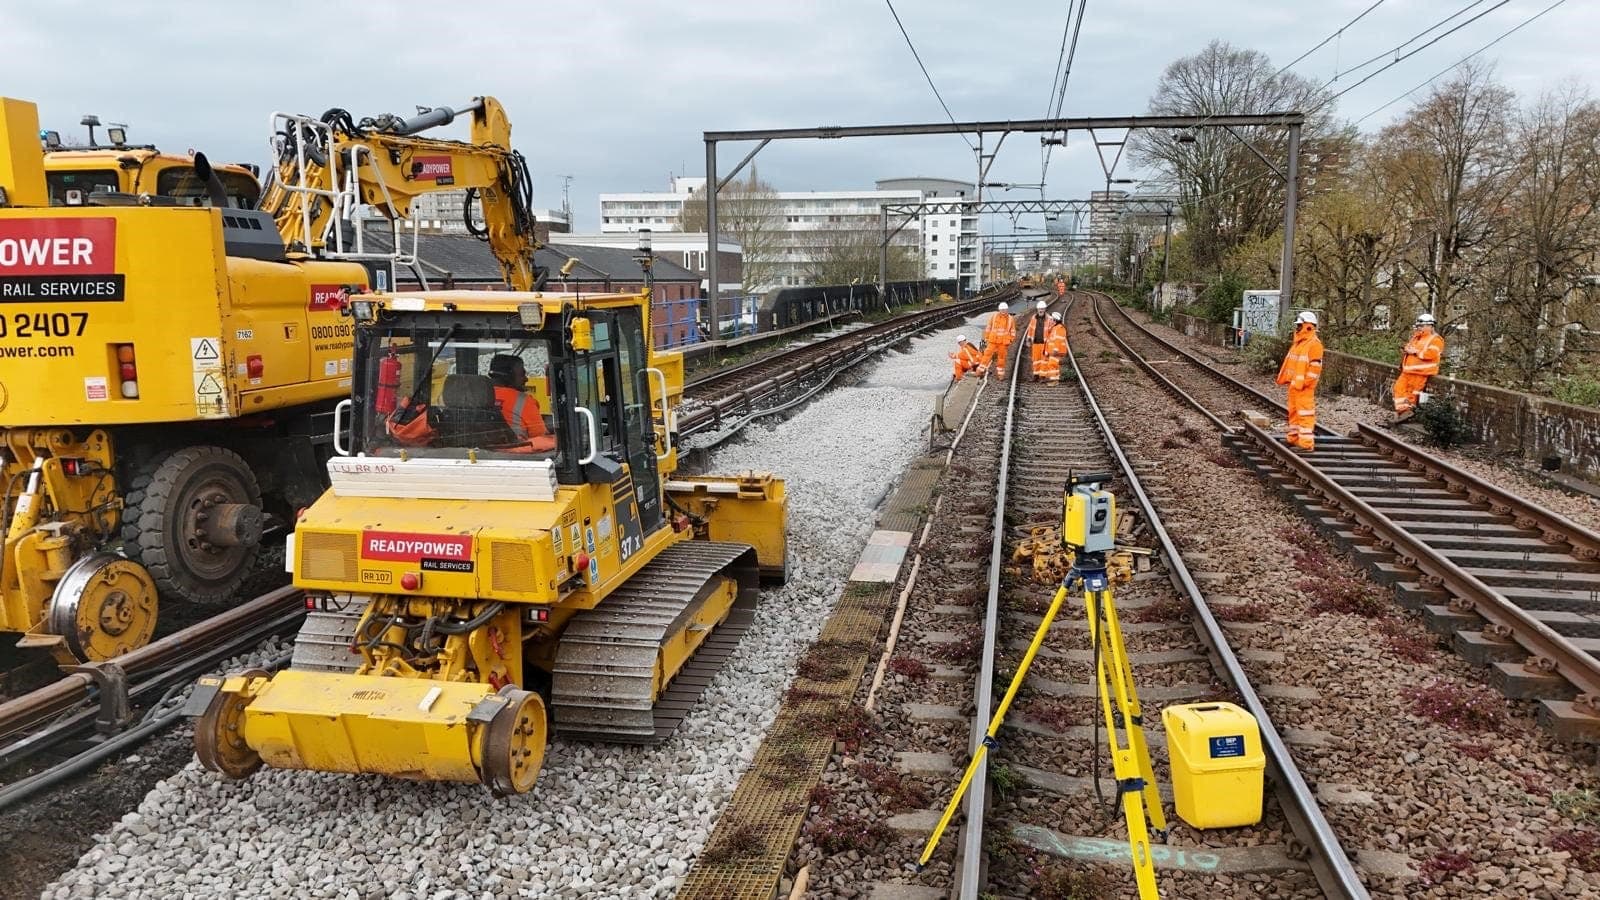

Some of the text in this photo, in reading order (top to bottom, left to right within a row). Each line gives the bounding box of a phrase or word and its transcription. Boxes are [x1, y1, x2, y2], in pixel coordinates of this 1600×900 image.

[3, 282, 116, 296] RAIL SERVICES
[15, 312, 89, 337] 2407
[312, 325, 334, 340] 0800
[335, 325, 350, 338] 090
[370, 539, 464, 556] READYPOWER
[621, 535, 632, 560] 37
[423, 561, 471, 570] RAIL SERVICES
[363, 572, 390, 582] RR 107
